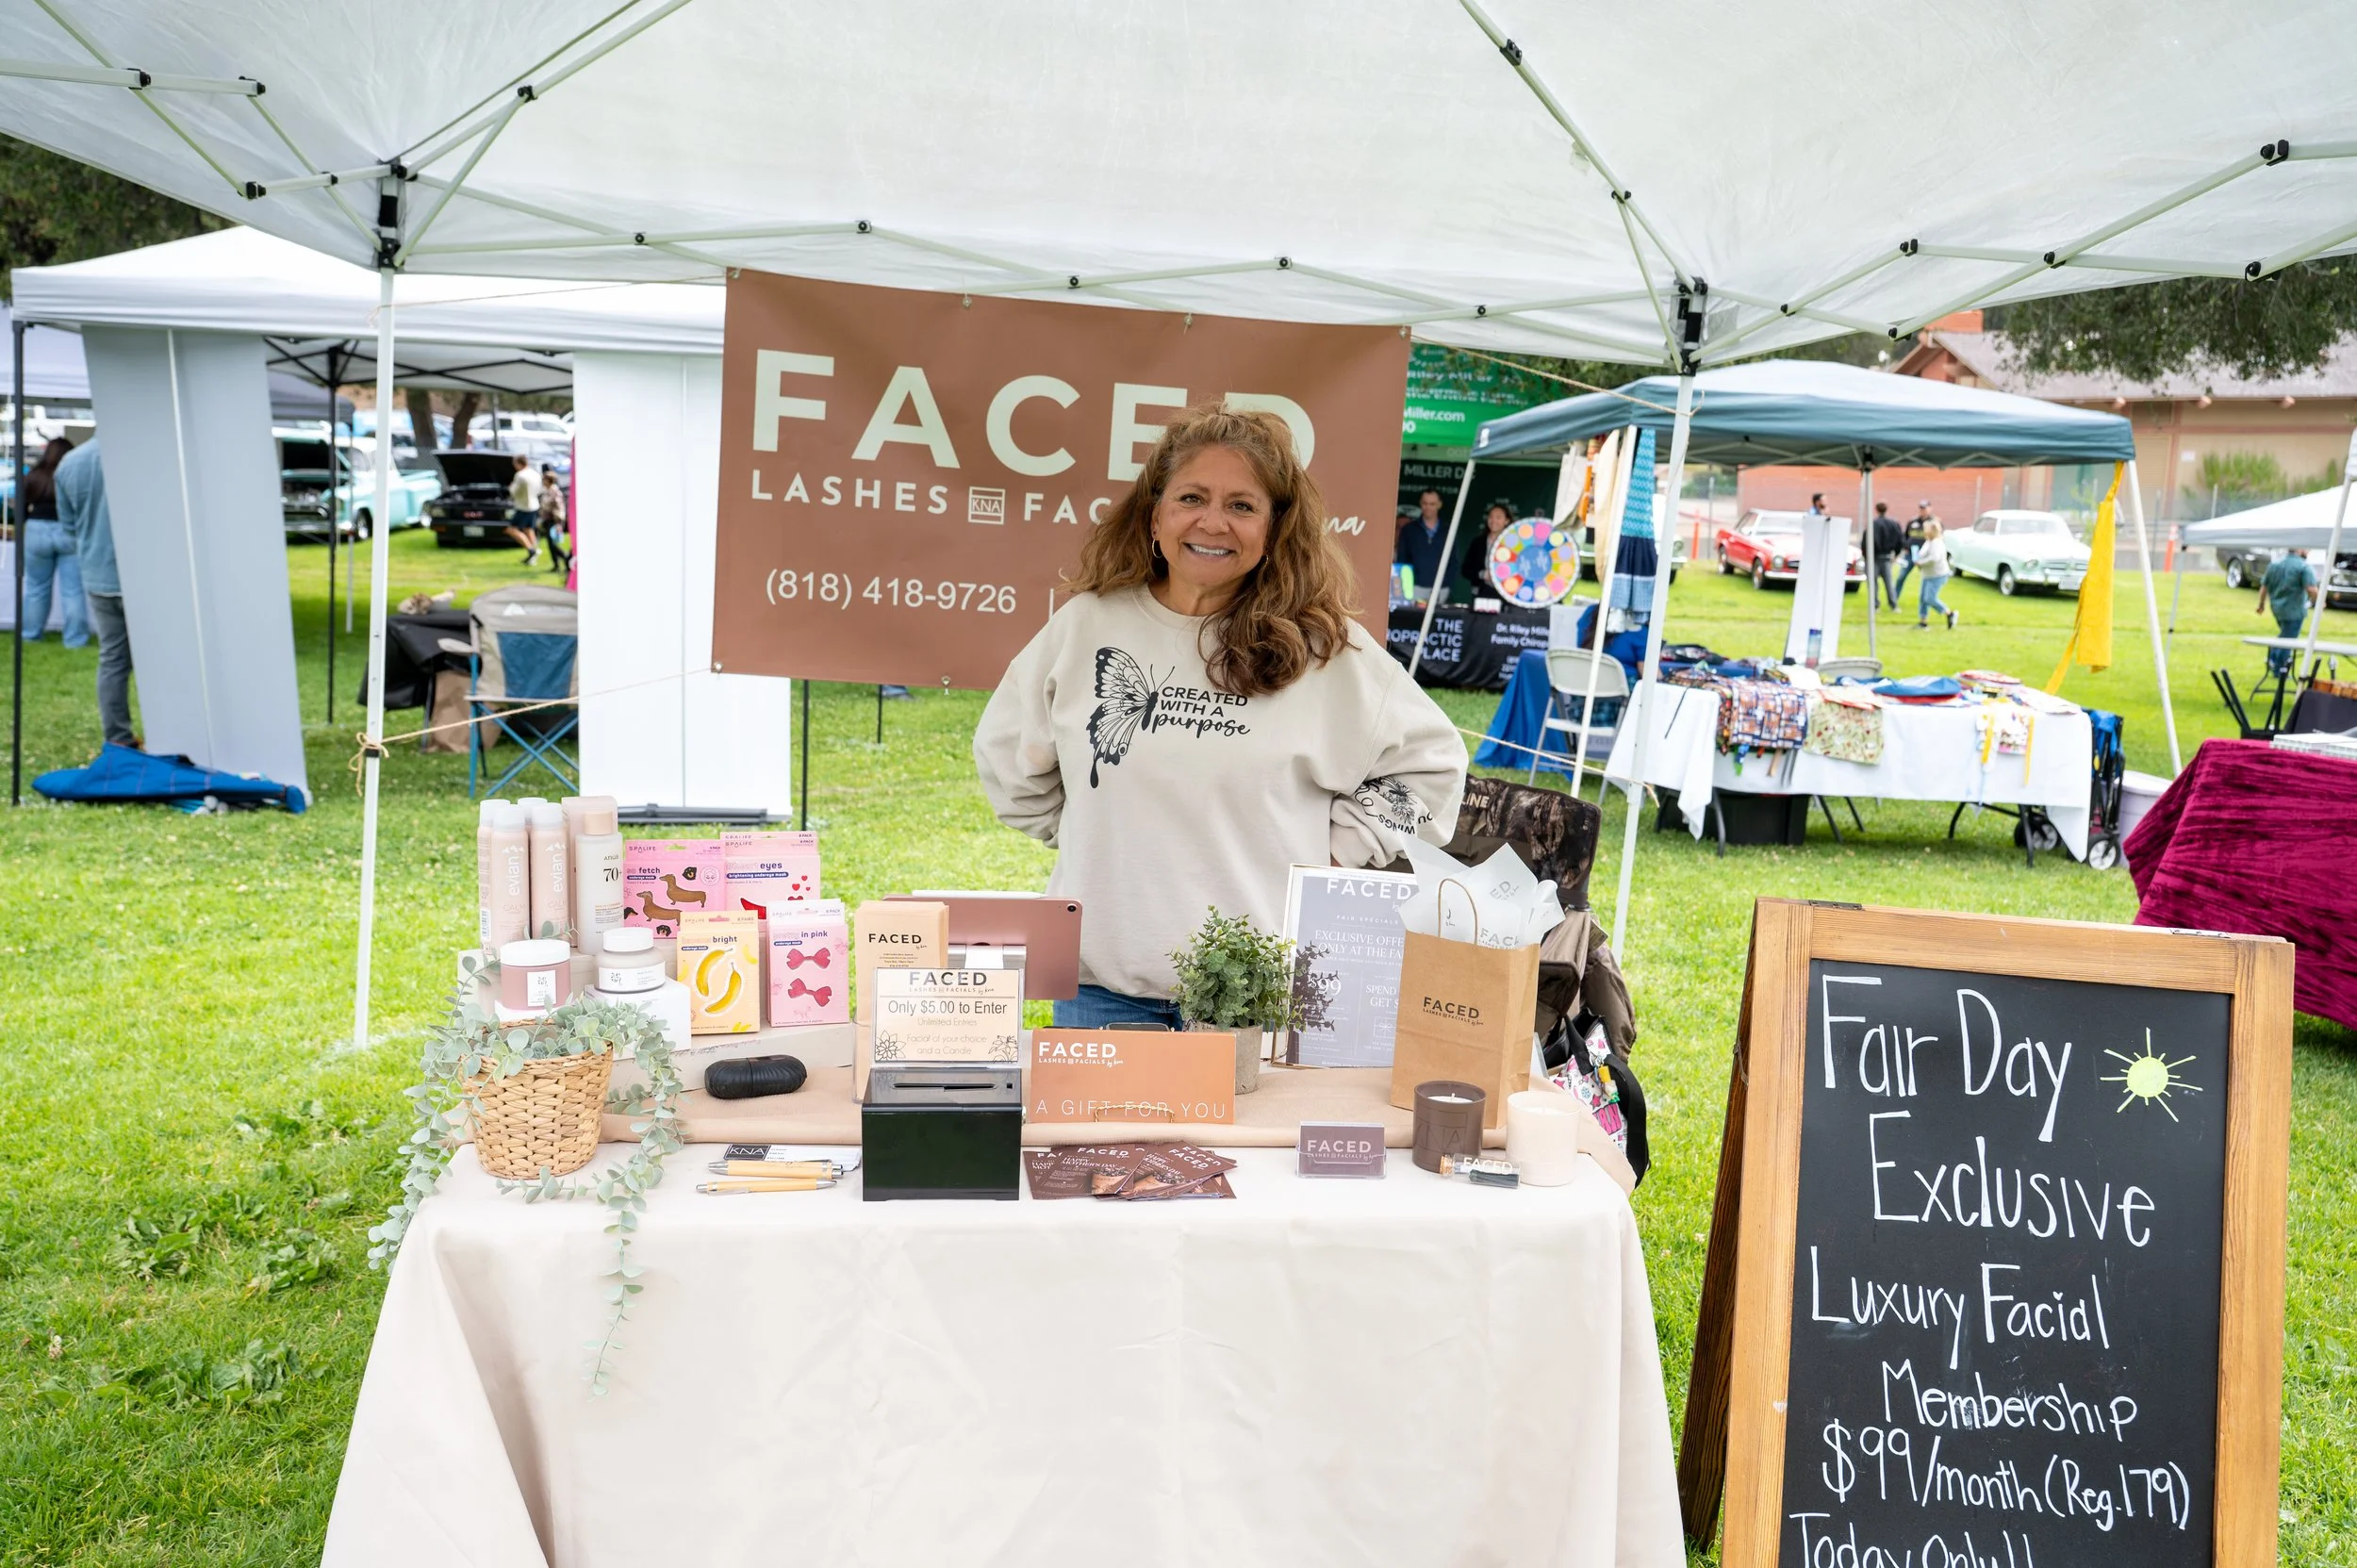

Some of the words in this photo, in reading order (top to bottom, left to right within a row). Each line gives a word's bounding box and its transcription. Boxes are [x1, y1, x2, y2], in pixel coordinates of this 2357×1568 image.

[752, 470, 948, 515] LASHES
[971, 498, 1002, 515] KNA
[766, 569, 852, 610] (818)
[862, 576, 1016, 614] 418-9726
[1436, 618, 1464, 634] THE
[1491, 634, 1519, 648] Family
[1162, 686, 1248, 707] CREATED
[1161, 700, 1207, 715] WITH
[1211, 706, 1224, 717] A
[1151, 713, 1251, 738] purpose
[508, 856, 520, 896] evian
[552, 853, 563, 893] evian
[1327, 878, 1411, 900] FACED
[811, 931, 828, 939] pink
[868, 933, 922, 944] FACED
[1315, 930, 1374, 944] EXCLUSIVE
[1376, 935, 1404, 947] OFFE
[1319, 943, 1348, 954] ONLY
[1350, 945, 1364, 955] AT
[1364, 946, 1387, 957] THE
[910, 971, 987, 986] FACED
[1366, 984, 1397, 996] SPEND
[888, 1000, 916, 1016] Only
[920, 1000, 955, 1015] $5.00
[959, 1002, 970, 1015] to
[975, 1001, 1007, 1015] Enter
[1370, 997, 1391, 1008] GET
[1424, 996, 1479, 1019] FACED
[917, 1017, 951, 1026] Unlimited
[907, 1033, 930, 1043] Facial
[943, 1036, 959, 1045] your
[961, 1033, 987, 1043] choice
[917, 1047, 933, 1055] and
[943, 1047, 972, 1055] Candle
[1039, 1042, 1116, 1058] FACED
[1822, 974, 1938, 1097] Fair
[1956, 988, 2071, 1142] Day
[1036, 1099, 1047, 1114] A
[1062, 1099, 1111, 1116] GIFT
[1124, 1101, 1168, 1117] FOR
[1180, 1102, 1225, 1118] YOU
[729, 1147, 765, 1155] KNA
[1077, 1147, 1129, 1156] FACED
[1307, 1140, 1372, 1153] FACED
[1169, 1148, 1209, 1168] FACED
[1870, 1111, 2155, 1247] Exclusive
[1810, 1246, 1965, 1370] Luxury
[1981, 1263, 2109, 1349] Facial
[1882, 1359, 2137, 1442] Membership
